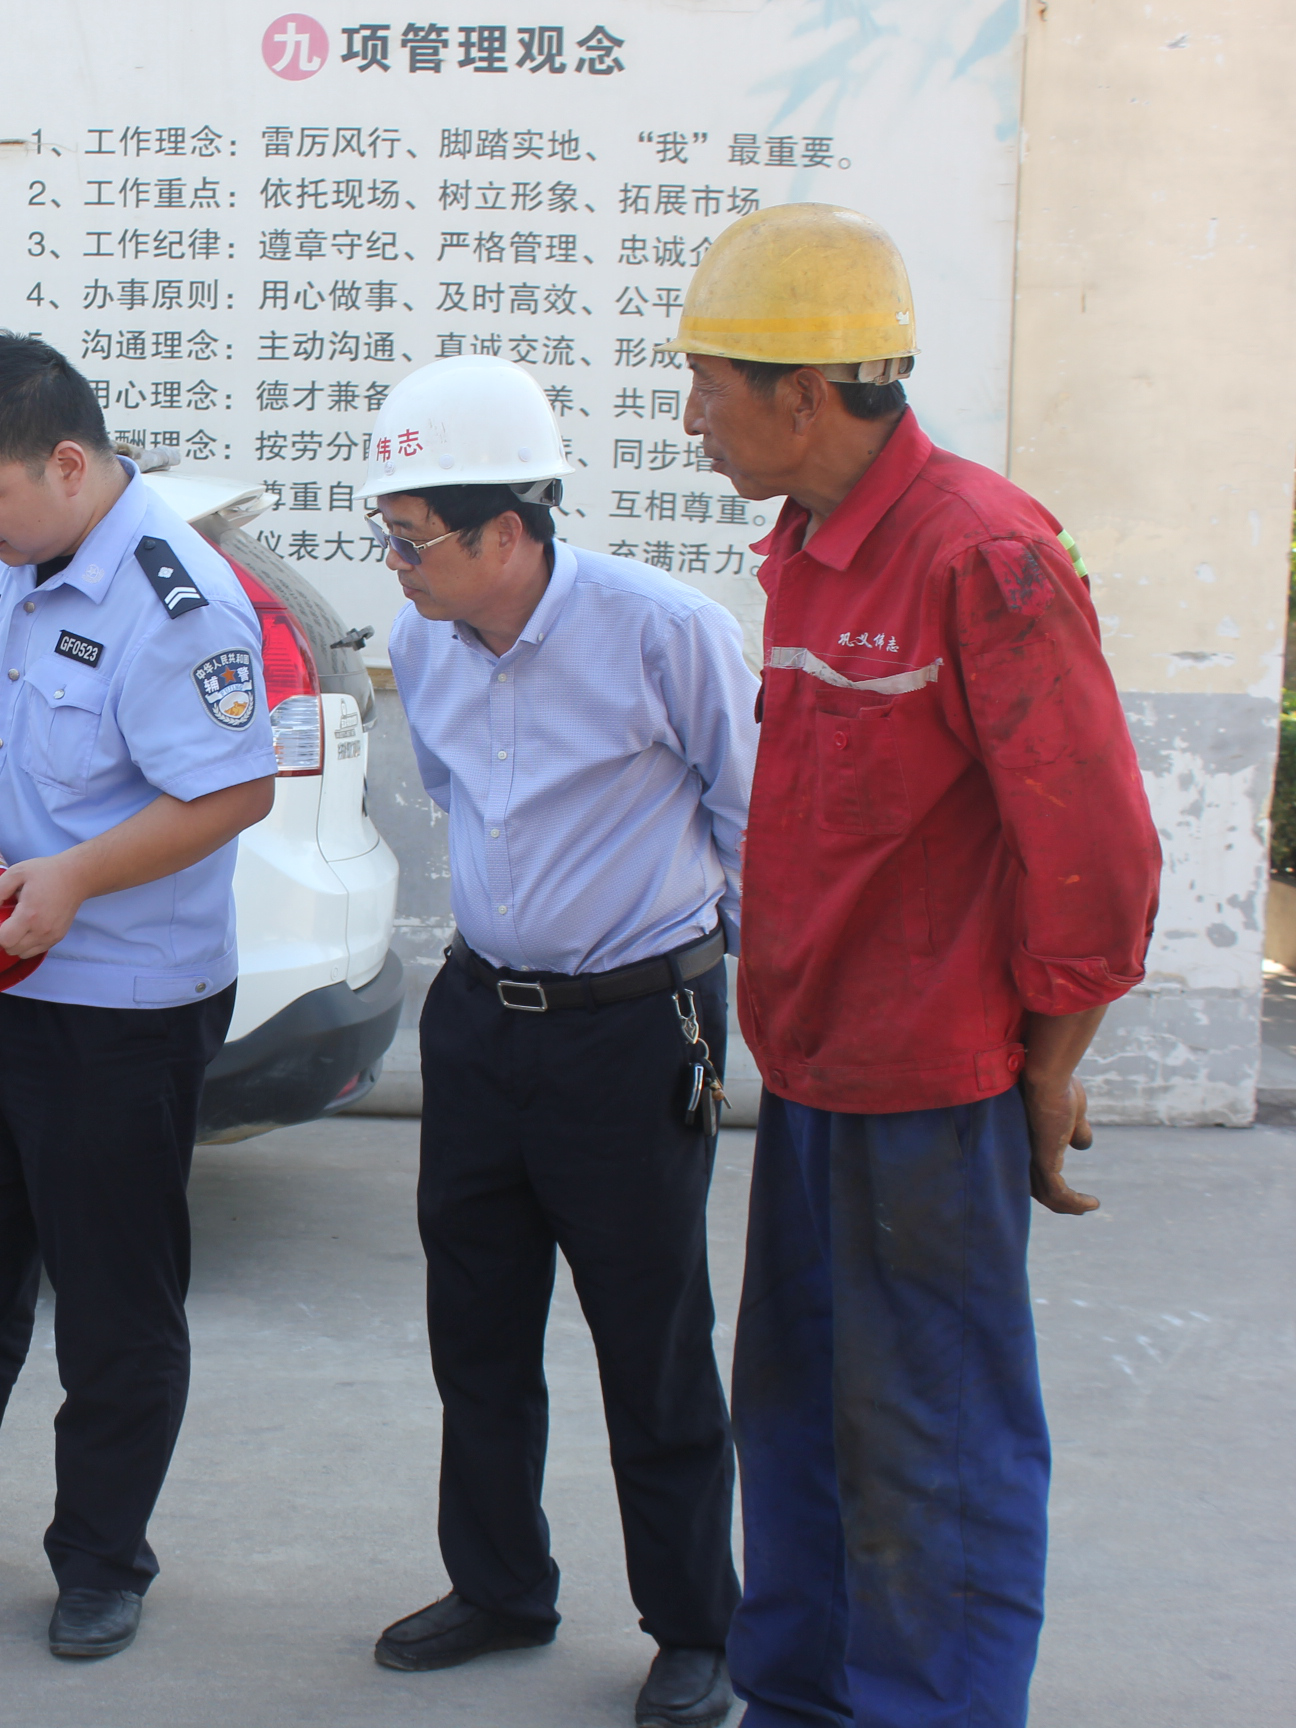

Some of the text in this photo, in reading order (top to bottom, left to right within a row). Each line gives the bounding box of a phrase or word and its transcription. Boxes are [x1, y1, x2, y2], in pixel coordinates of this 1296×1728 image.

[272, 22, 626, 75] 九 项管理观念
[376, 429, 423, 462] 伟志
[60, 636, 99, 662] GF0523
[195, 653, 250, 680] 中华人民共和国
